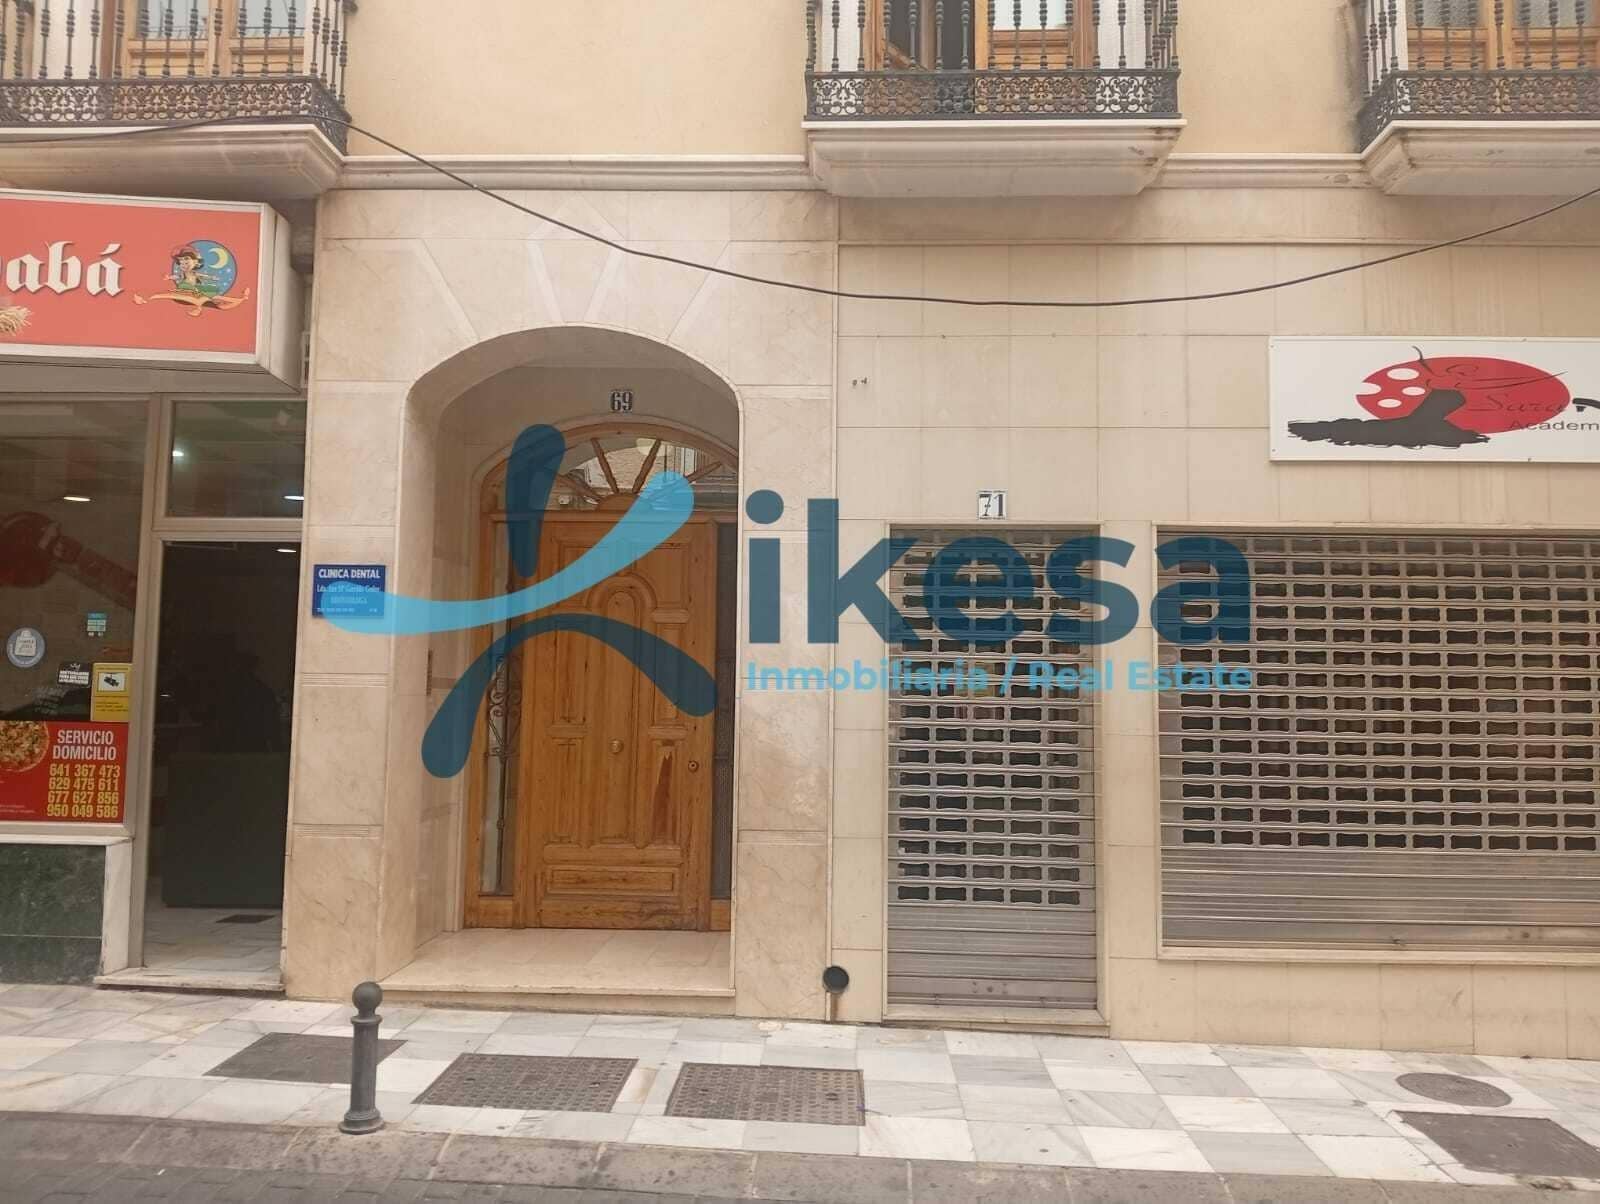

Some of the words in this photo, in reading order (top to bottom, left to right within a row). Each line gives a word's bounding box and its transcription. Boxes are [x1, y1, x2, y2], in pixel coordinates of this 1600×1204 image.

[0, 240, 125, 297] abá
[611, 391, 633, 411] 69
[979, 493, 1003, 517] 71
[351, 569, 381, 579] DENTAL
[57, 730, 114, 745] SERVICIO
[52, 745, 117, 761] DOMICILIO
[49, 763, 70, 777] 641
[74, 764, 96, 777] 367
[99, 765, 121, 778] 473
[73, 778, 95, 790] 475
[98, 778, 119, 791] 611
[47, 790, 70, 804] 677
[72, 791, 94, 804] 627
[46, 804, 69, 817] 950
